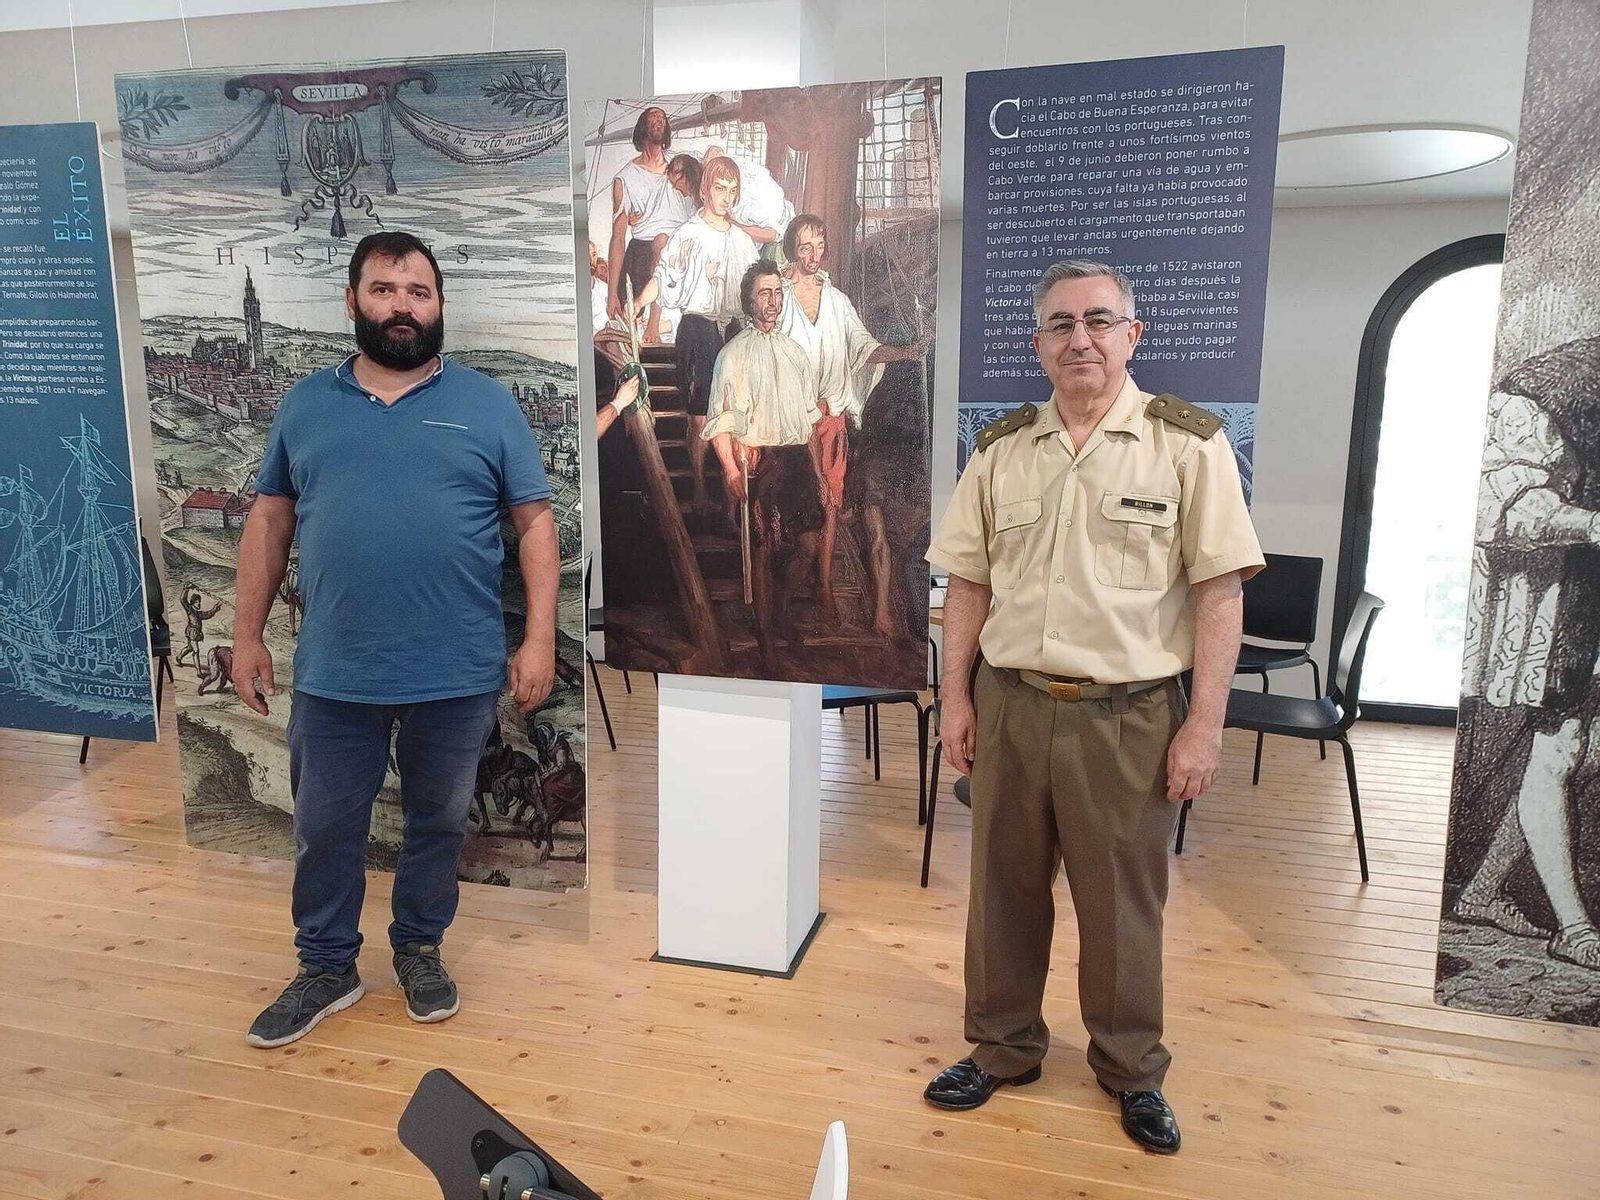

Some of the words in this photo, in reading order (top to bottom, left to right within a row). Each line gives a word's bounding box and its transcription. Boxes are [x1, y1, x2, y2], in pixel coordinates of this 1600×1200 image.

[1037, 95, 1047, 106] la
[1050, 95, 1076, 105] nave
[1079, 94, 1092, 103] en
[1096, 90, 1117, 102] mal
[1120, 87, 1157, 100] estado
[1160, 87, 1173, 97] se
[1176, 83, 1231, 97] dirigieron
[1020, 112, 1036, 123] cia
[1037, 110, 1047, 122] el
[1049, 109, 1076, 120] Cabo
[1078, 108, 1091, 119] de
[1093, 106, 1127, 118] Buena
[1130, 102, 1190, 116] Esperanza,
[1192, 100, 1218, 113] para
[1220, 96, 1254, 108] evitar
[1020, 125, 1079, 138] encuentros
[1082, 124, 1101, 134] con
[1105, 121, 1121, 132] los
[1124, 118, 1195, 133] portugueses.
[1198, 114, 1223, 125] Tras
[454, 132, 467, 146] ha
[988, 143, 1021, 157] seguir
[1024, 140, 1068, 153] doblarlo
[1072, 138, 1104, 150] frente
[1107, 139, 1115, 148] a
[1119, 137, 1145, 147] unos
[1149, 132, 1206, 145] fortísimos
[1210, 128, 1251, 141] vientos
[988, 159, 1004, 171] del
[1007, 158, 1038, 169] oeste,
[1044, 156, 1054, 167] el
[1058, 155, 1065, 166] 9
[1068, 154, 1081, 166] de
[1084, 153, 1111, 167] junio
[1114, 150, 1162, 163] debieron
[1165, 149, 1198, 161] poner
[1201, 144, 1239, 157] rumbo
[1242, 145, 1250, 155] a
[987, 174, 1013, 186] Cabo
[1016, 172, 1046, 184] Verde
[1050, 172, 1073, 184] para
[1077, 169, 1118, 181] reparar
[1121, 168, 1142, 178] una
[1145, 165, 1161, 176] vía
[1165, 164, 1180, 175] de
[1183, 164, 1211, 176] agua
[1214, 163, 1222, 174] y
[987, 190, 1021, 200] barcar
[1023, 186, 1085, 200] provisiones,
[1087, 185, 1112, 196] cuya
[1115, 182, 1139, 193] falta
[1141, 183, 1154, 194] ya
[1157, 178, 1187, 191] había
[1189, 175, 1248, 191] provocado
[68, 155, 94, 243] ÉXITO
[986, 204, 1018, 215] varias
[1021, 202, 1067, 213] muertes.
[1070, 200, 1089, 210] Por
[1092, 200, 1110, 210] ser
[1113, 198, 1129, 208] las
[1132, 196, 1158, 207] islas
[1160, 194, 1233, 208] portuguesas,
[1235, 190, 1247, 202] al
[986, 221, 1003, 230] ser
[1005, 216, 1065, 229] descubierto
[1067, 215, 1077, 226] el
[1079, 213, 1142, 227] cargamento
[1144, 213, 1165, 224] que
[1166, 207, 1245, 222] transportaban
[52, 211, 71, 243] EL
[986, 233, 1027, 245] tuvieron
[1030, 234, 1050, 244] que
[1053, 231, 1079, 241] levar
[1082, 229, 1117, 240] anclas
[1120, 225, 1197, 240] urgentemente
[1200, 222, 1245, 236] dejando
[985, 251, 998, 260] en
[1001, 248, 1028, 259] tierra
[1031, 249, 1037, 257] a
[1041, 246, 1053, 257] 13
[1056, 245, 1112, 256] marineros.
[1145, 261, 1158, 272] de
[1162, 260, 1188, 272] 1522
[1190, 259, 1242, 270] avistaron
[1154, 276, 1177, 287] días
[1180, 274, 1227, 287] después
[1230, 273, 1241, 284] la
[984, 282, 994, 293] el
[997, 282, 1022, 293] cabo
[1168, 293, 1175, 301] a
[1217, 288, 1240, 300] casi
[985, 296, 1022, 307] Victoria
[1022, 296, 1034, 306] al
[984, 312, 1004, 322] tres
[1005, 310, 1030, 321] años
[1145, 306, 1158, 316] 18
[1159, 304, 1239, 318] supervivientes
[983, 327, 1002, 338] que
[1153, 321, 1189, 333] leguas
[1192, 319, 1238, 330] marinas
[983, 342, 989, 352] y
[991, 341, 1010, 350] con
[1012, 341, 1025, 349] un
[1151, 337, 1171, 347] que
[1174, 334, 1202, 347] pudo
[1204, 335, 1237, 346] pagar
[982, 354, 998, 364] las
[999, 353, 1026, 364] cinco
[1135, 350, 1178, 360] salarios
[1180, 351, 1187, 362] y
[1189, 348, 1236, 361] producir
[982, 367, 1022, 378] además
